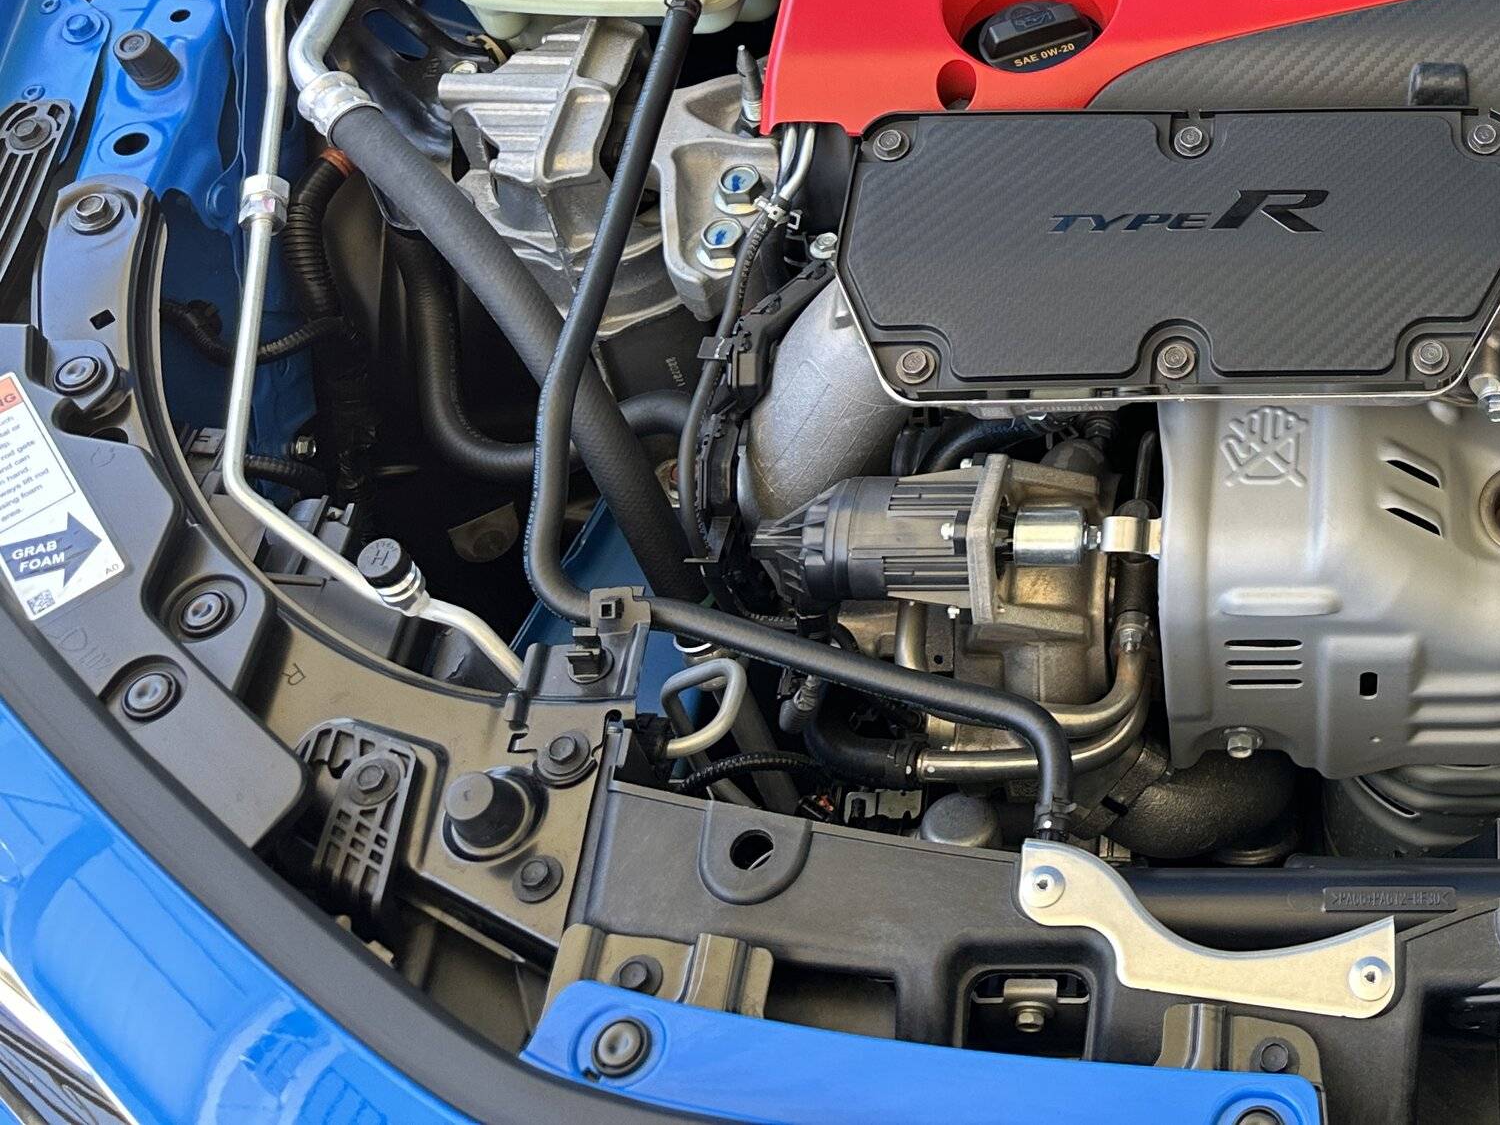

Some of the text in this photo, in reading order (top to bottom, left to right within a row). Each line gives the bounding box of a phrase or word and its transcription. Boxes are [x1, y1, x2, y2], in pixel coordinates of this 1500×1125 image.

[1014, 42, 1076, 67] SAE 0W-20
[1048, 189, 1330, 234] TYPE R
[11, 540, 57, 560] GRAB
[19, 552, 65, 573] FOAM
